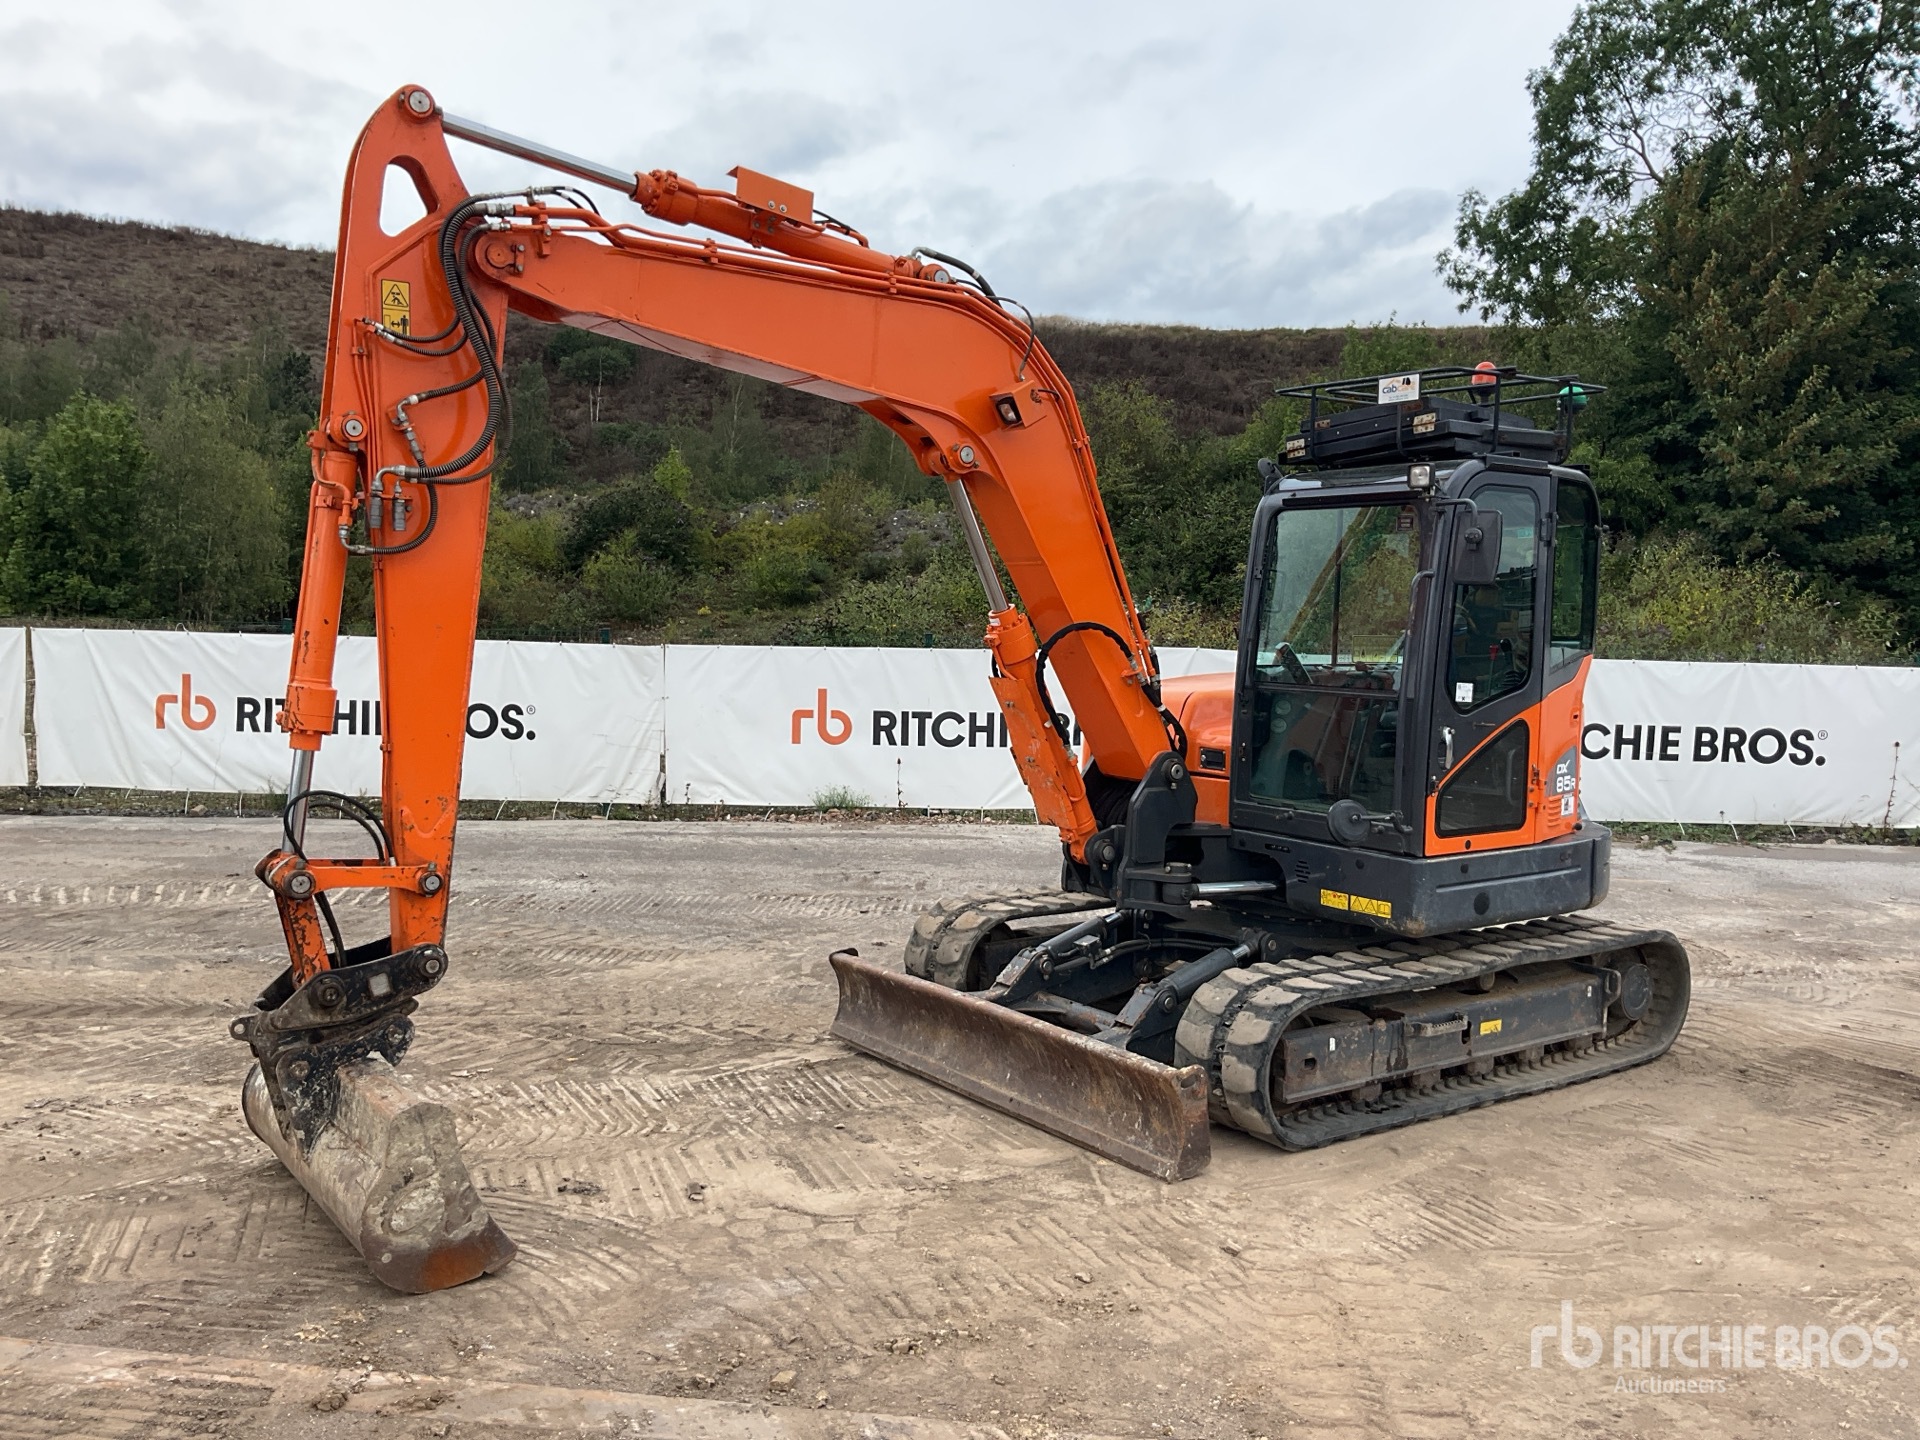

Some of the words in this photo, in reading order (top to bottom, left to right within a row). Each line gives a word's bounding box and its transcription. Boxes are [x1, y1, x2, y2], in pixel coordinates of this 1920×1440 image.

[154, 673, 216, 731] rb
[236, 697, 382, 735] RIHI
[792, 688, 852, 745] rb
[873, 710, 1008, 748] RITCHI
[1581, 723, 1681, 761] CHIE
